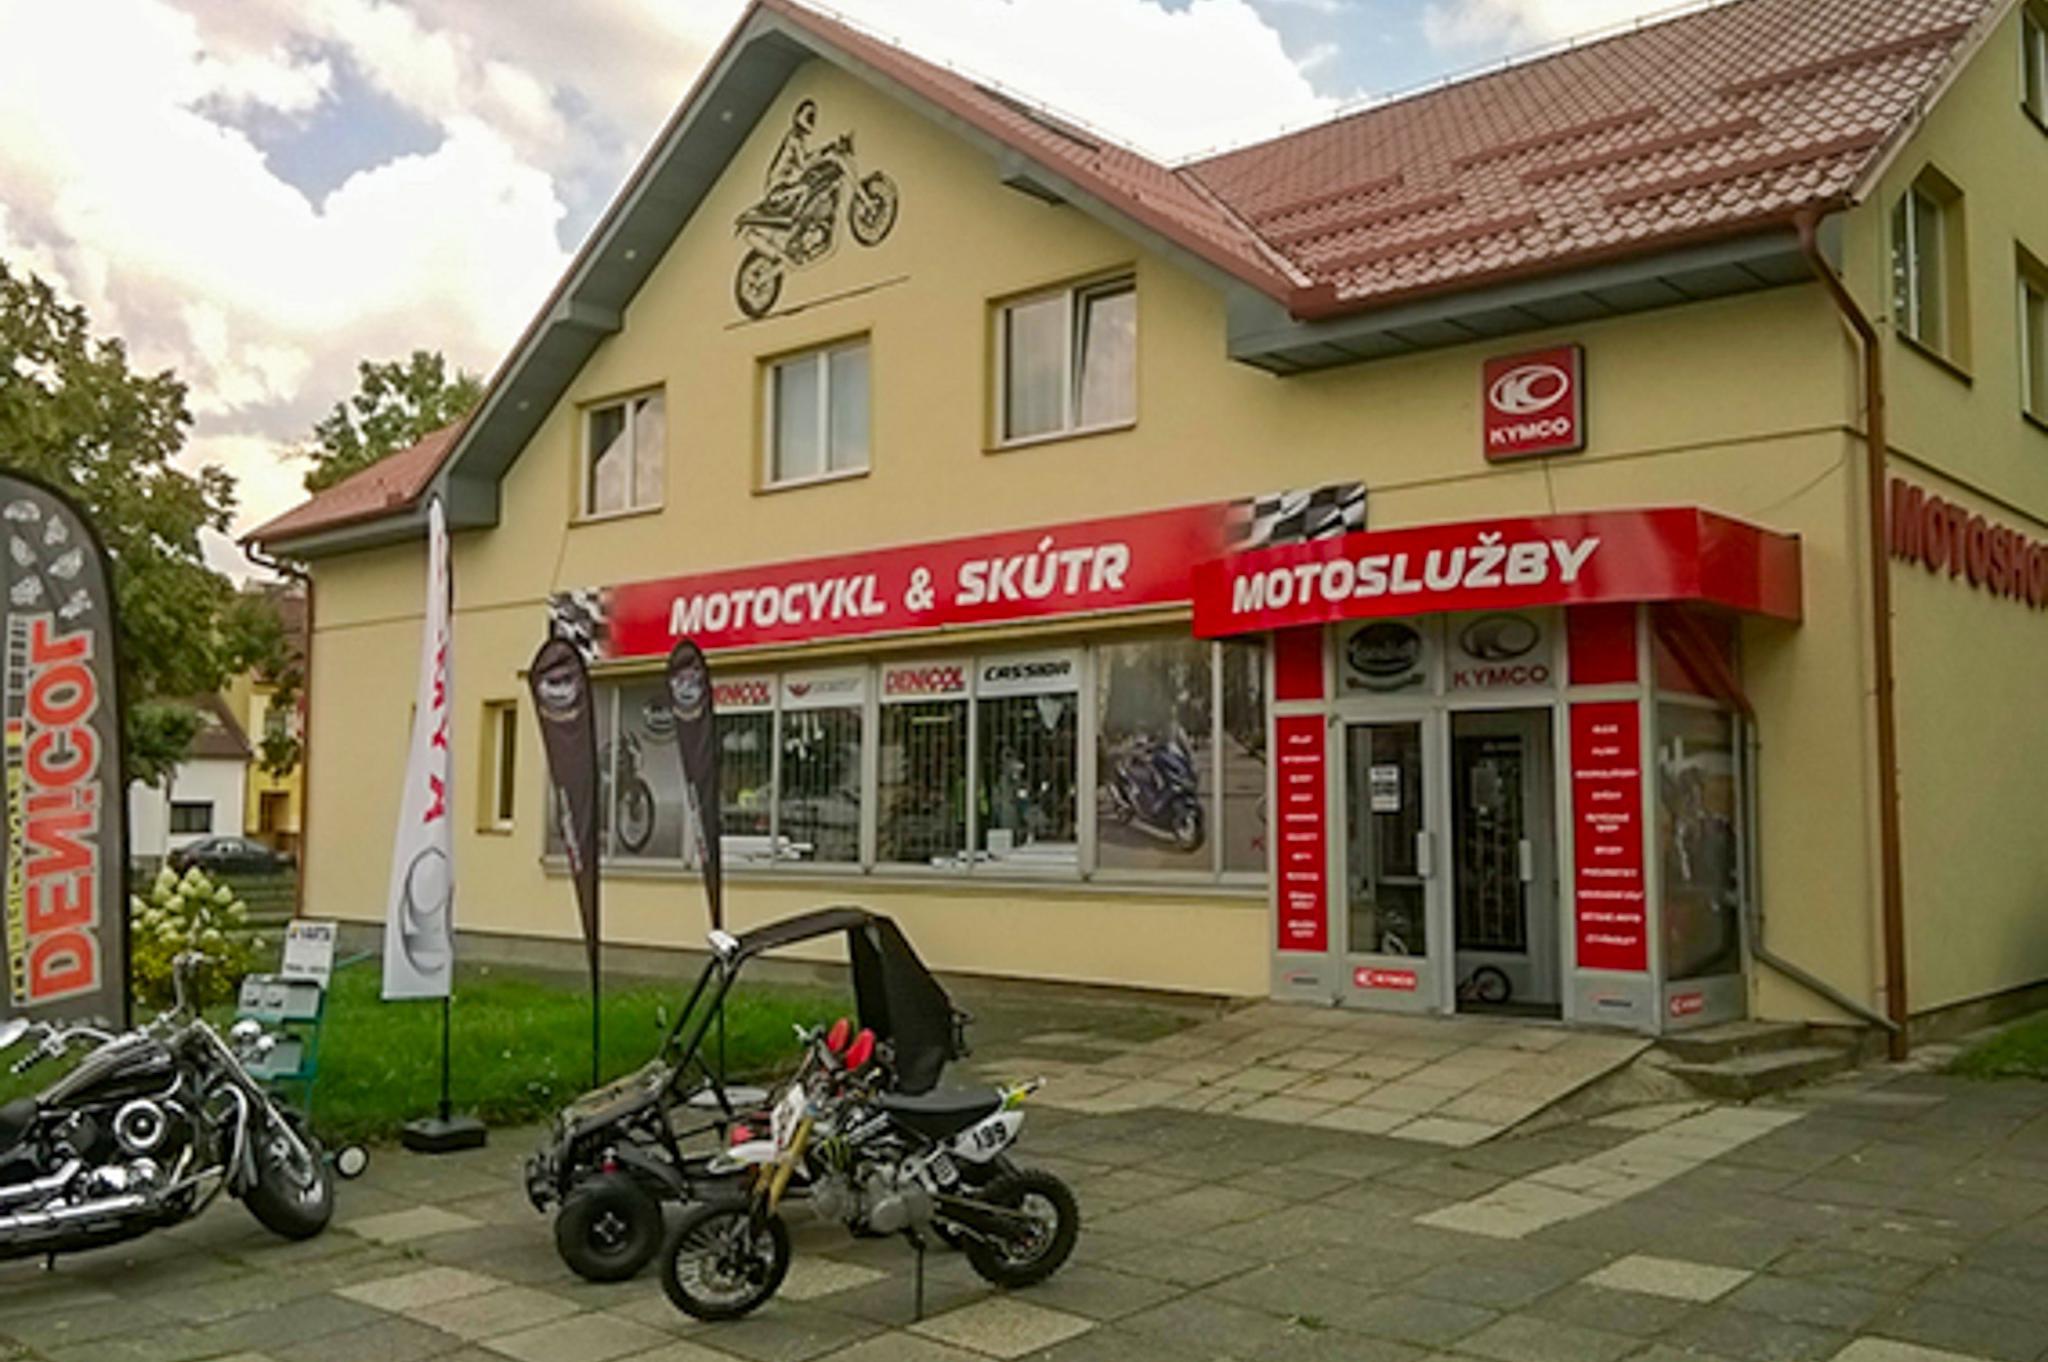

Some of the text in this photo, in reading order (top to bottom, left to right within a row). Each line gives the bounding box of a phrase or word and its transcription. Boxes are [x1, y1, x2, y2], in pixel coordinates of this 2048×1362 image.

[1490, 417, 1571, 444] KYMCO
[668, 535, 1131, 636] MOTOCYKL & SKÚTR
[1232, 531, 1601, 614] MOTOSLUŽBY
[1453, 664, 1549, 688] KYMCO
